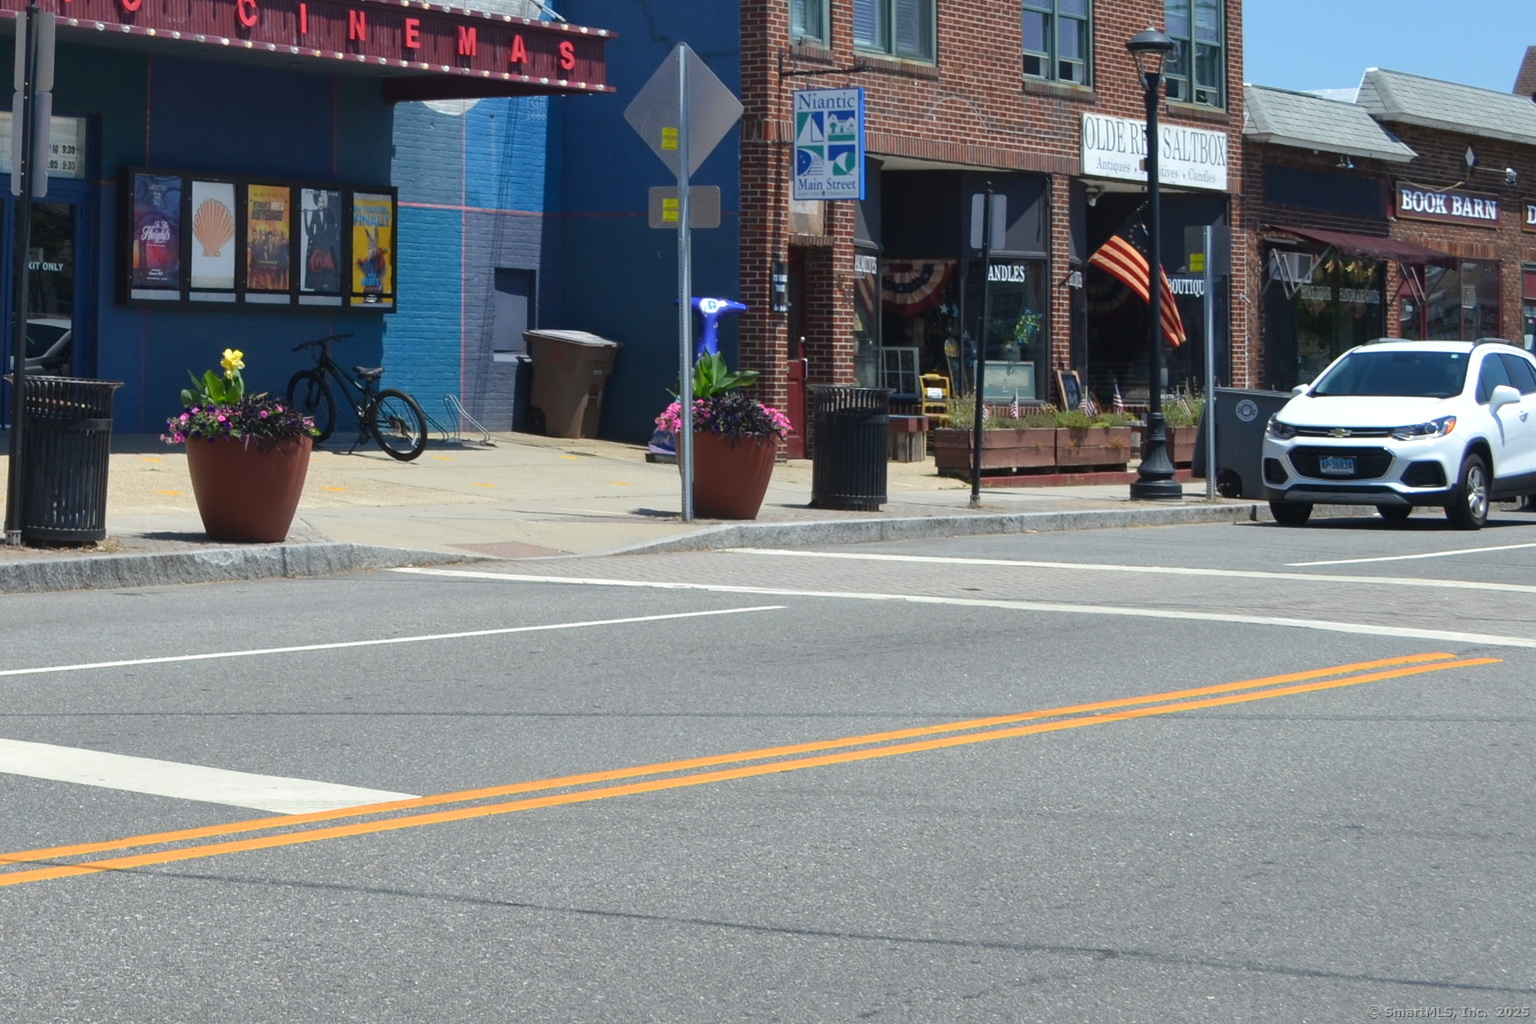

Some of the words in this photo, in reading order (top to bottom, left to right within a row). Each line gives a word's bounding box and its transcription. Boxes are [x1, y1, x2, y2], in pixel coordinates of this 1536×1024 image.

[798, 92, 856, 110] Niantic
[1084, 116, 1126, 154] OLDE
[1129, 122, 1148, 156] RE
[1163, 127, 1226, 167] SALTBOX
[1096, 157, 1131, 174] Antiques
[1188, 168, 1216, 184] Candles
[798, 178, 823, 190] Main
[826, 177, 856, 190] Street
[1401, 189, 1448, 215] BOOK
[1451, 195, 1497, 220] BARN
[353, 213, 391, 227] FINALLY
[42, 262, 64, 271] ONLY
[987, 264, 1025, 283] ANDLES
